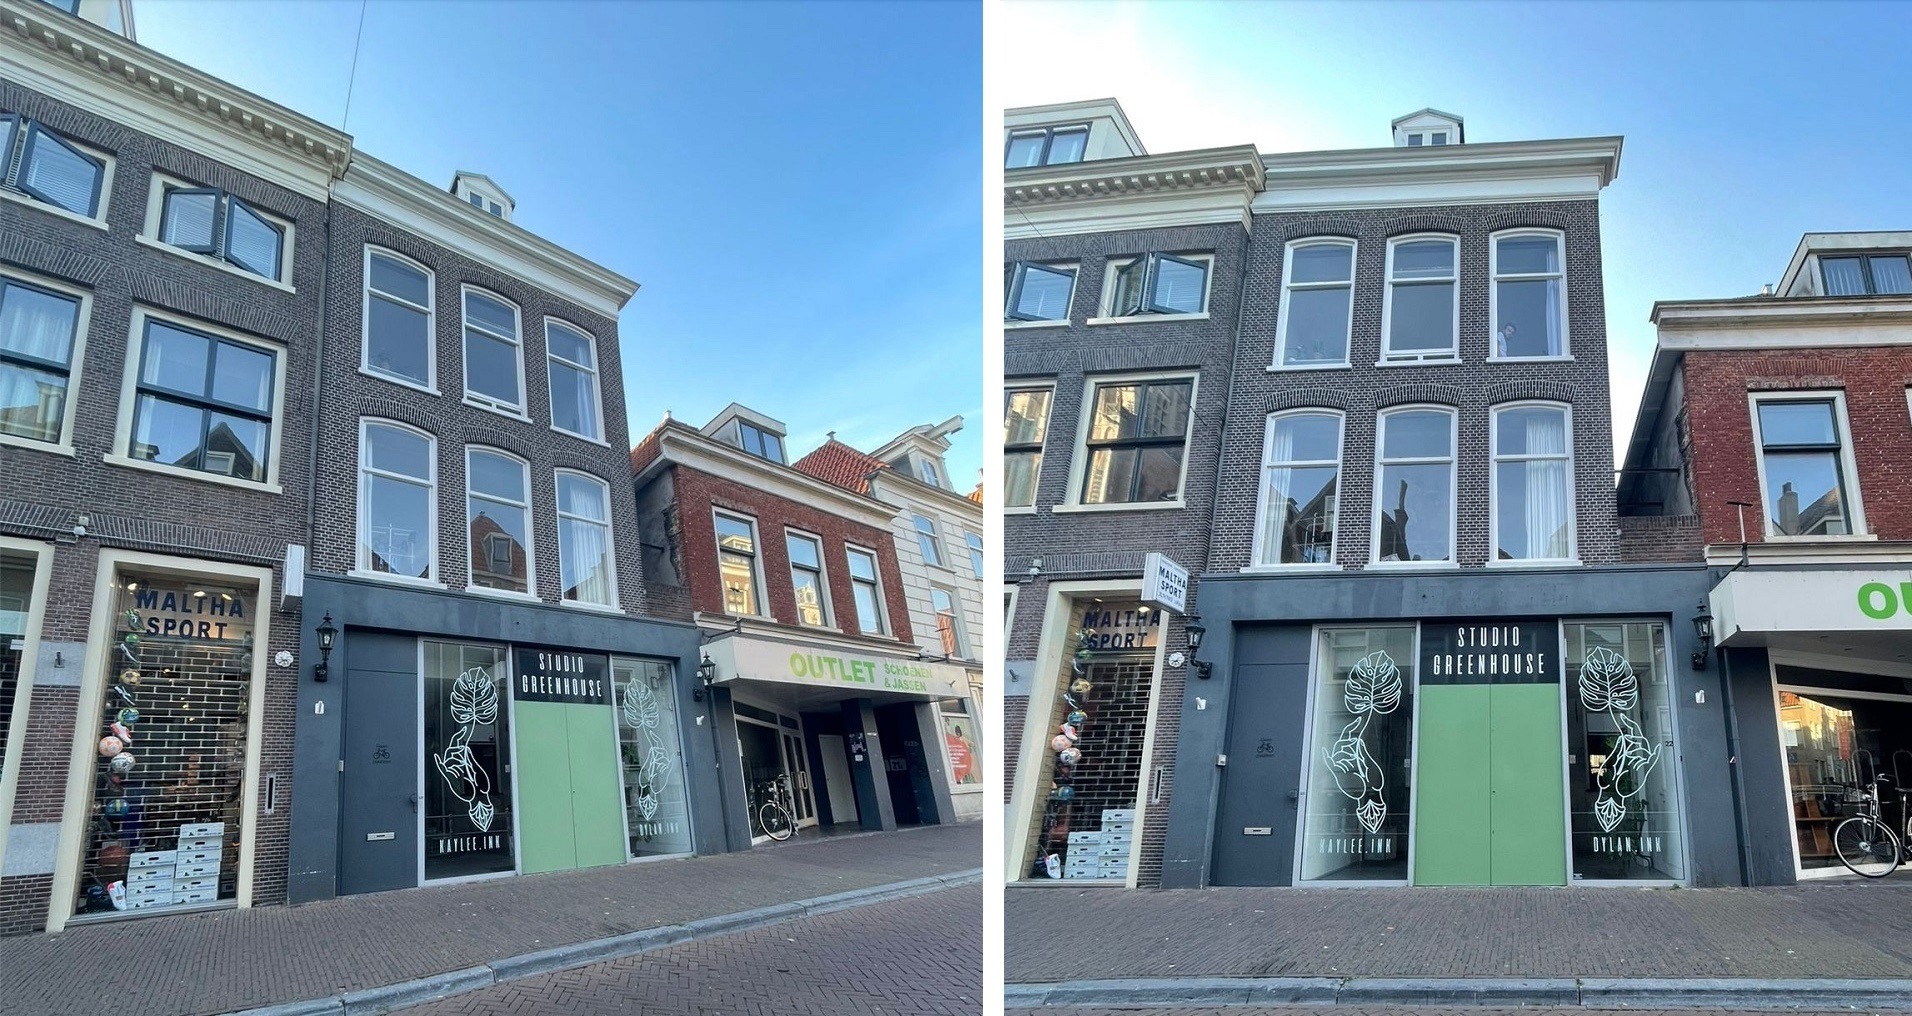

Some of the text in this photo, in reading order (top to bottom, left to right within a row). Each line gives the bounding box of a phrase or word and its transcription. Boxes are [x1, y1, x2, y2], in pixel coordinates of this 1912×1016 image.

[1159, 566, 1187, 590] MALTHA
[1160, 580, 1182, 599] SPORT
[136, 588, 243, 618] MALTHA
[146, 617, 228, 640] SPORT
[1083, 610, 1160, 628] MALTHA
[1088, 632, 1148, 649] SPORT
[1458, 626, 1520, 647] STUDIO
[539, 652, 584, 673] STUDIO
[789, 652, 876, 683] OUTLET
[884, 662, 933, 679] SCHOENEN
[1433, 653, 1545, 675] GREENHOUSE
[522, 674, 602, 697] GREENHOUSE
[884, 678, 927, 692] & JASSEN
[439, 835, 500, 854] KAYLEE.INK
[1319, 838, 1391, 854] KAYLEE.INK
[1593, 836, 1661, 853] DYLAN.INK
